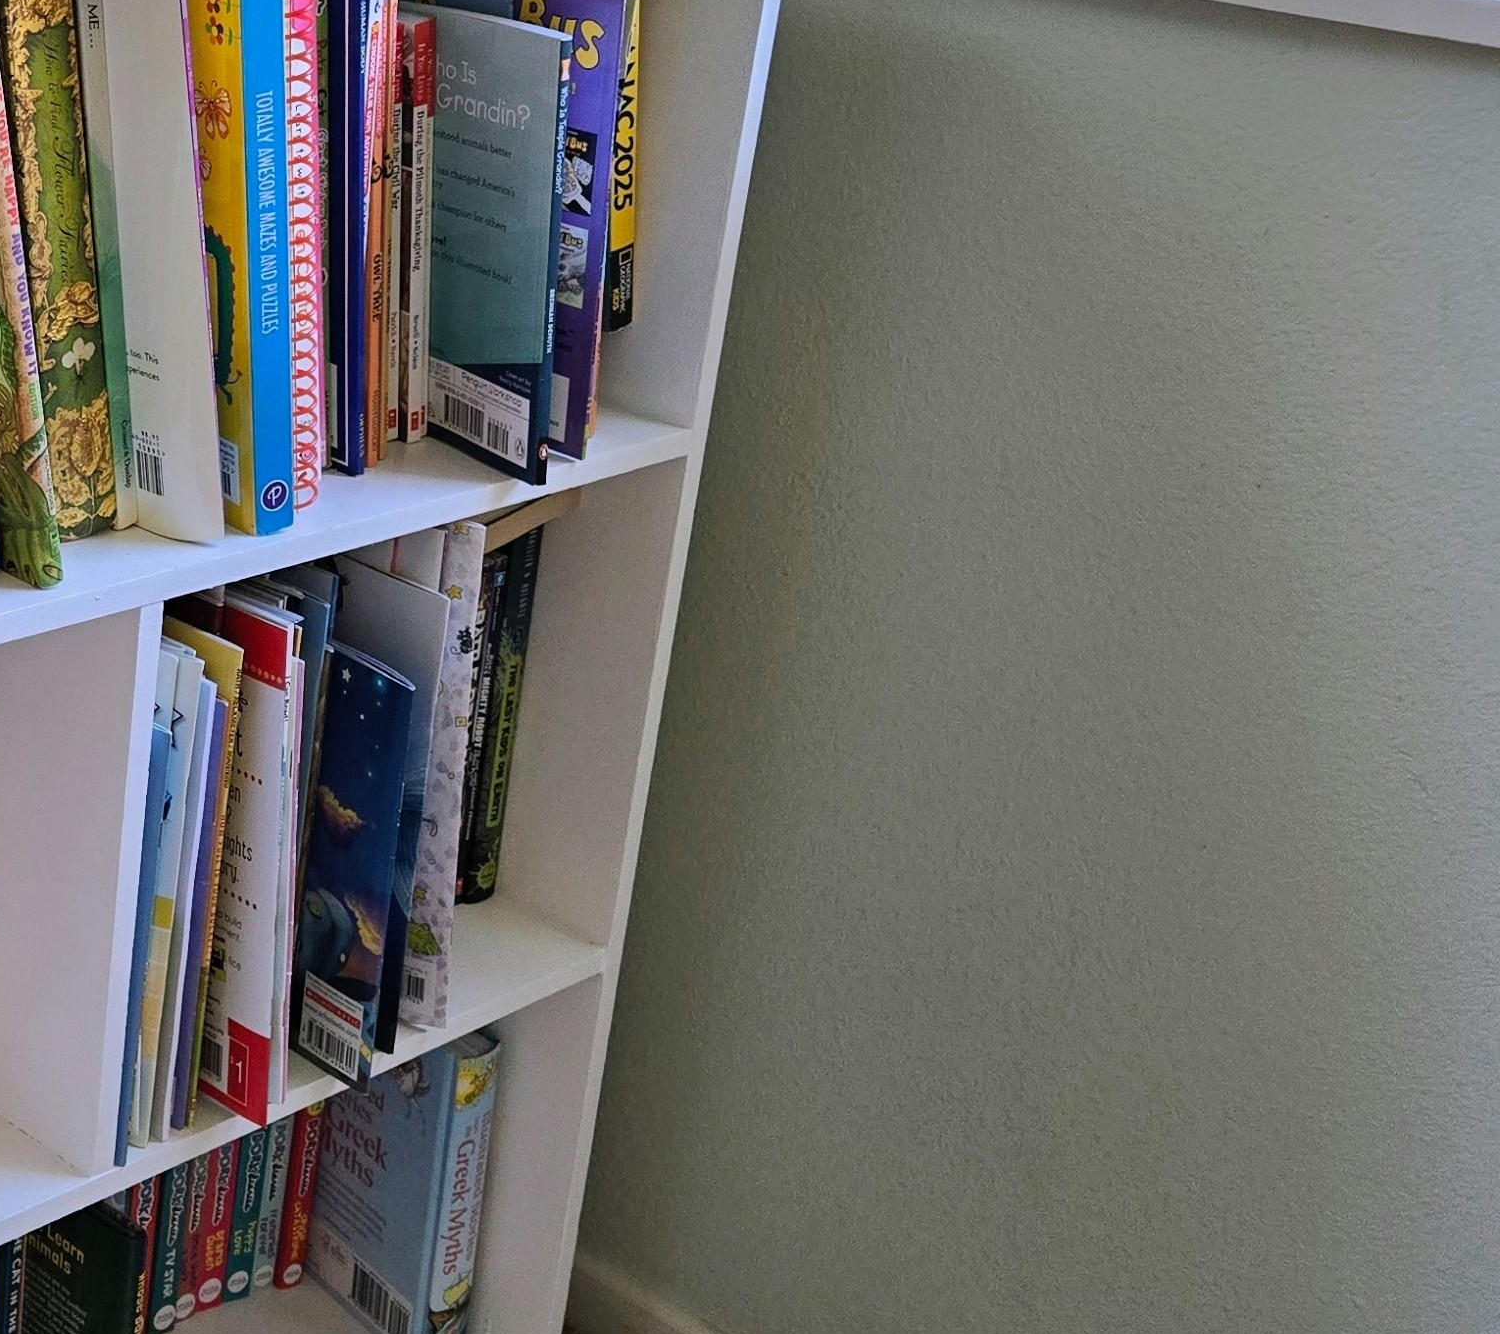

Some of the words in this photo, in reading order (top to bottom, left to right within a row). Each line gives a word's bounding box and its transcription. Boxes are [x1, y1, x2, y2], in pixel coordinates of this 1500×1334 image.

[436, 55, 457, 80] ho
[461, 60, 477, 86] Is
[255, 90, 275, 143] TOTALLY
[436, 82, 531, 131] Grandin?
[53, 137, 76, 212] Flower
[257, 146, 277, 210] AWESOME
[613, 136, 634, 212] 2025
[3, 174, 21, 229] HAPPY
[9, 232, 25, 266] AND
[59, 212, 82, 284] Fairies
[259, 210, 278, 248] MAZES
[261, 249, 278, 277] AND
[14, 268, 29, 305] YOU
[612, 287, 620, 311] KIDS
[261, 280, 279, 336] PUZZLES
[18, 305, 35, 358] KNOW
[25, 359, 38, 377] IT
[144, 353, 159, 366] This
[28, 381, 40, 421] EDITION
[505, 690, 516, 722] LAST
[500, 722, 510, 760] KIDS
[489, 776, 504, 823] EARTH
[235, 1060, 243, 1084] 1
[450, 1138, 476, 1204] Greek
[46, 1223, 86, 1265] Learn
[164, 1248, 177, 1266] TV
[439, 1206, 468, 1277] Myths
[162, 1268, 175, 1299] STAR
